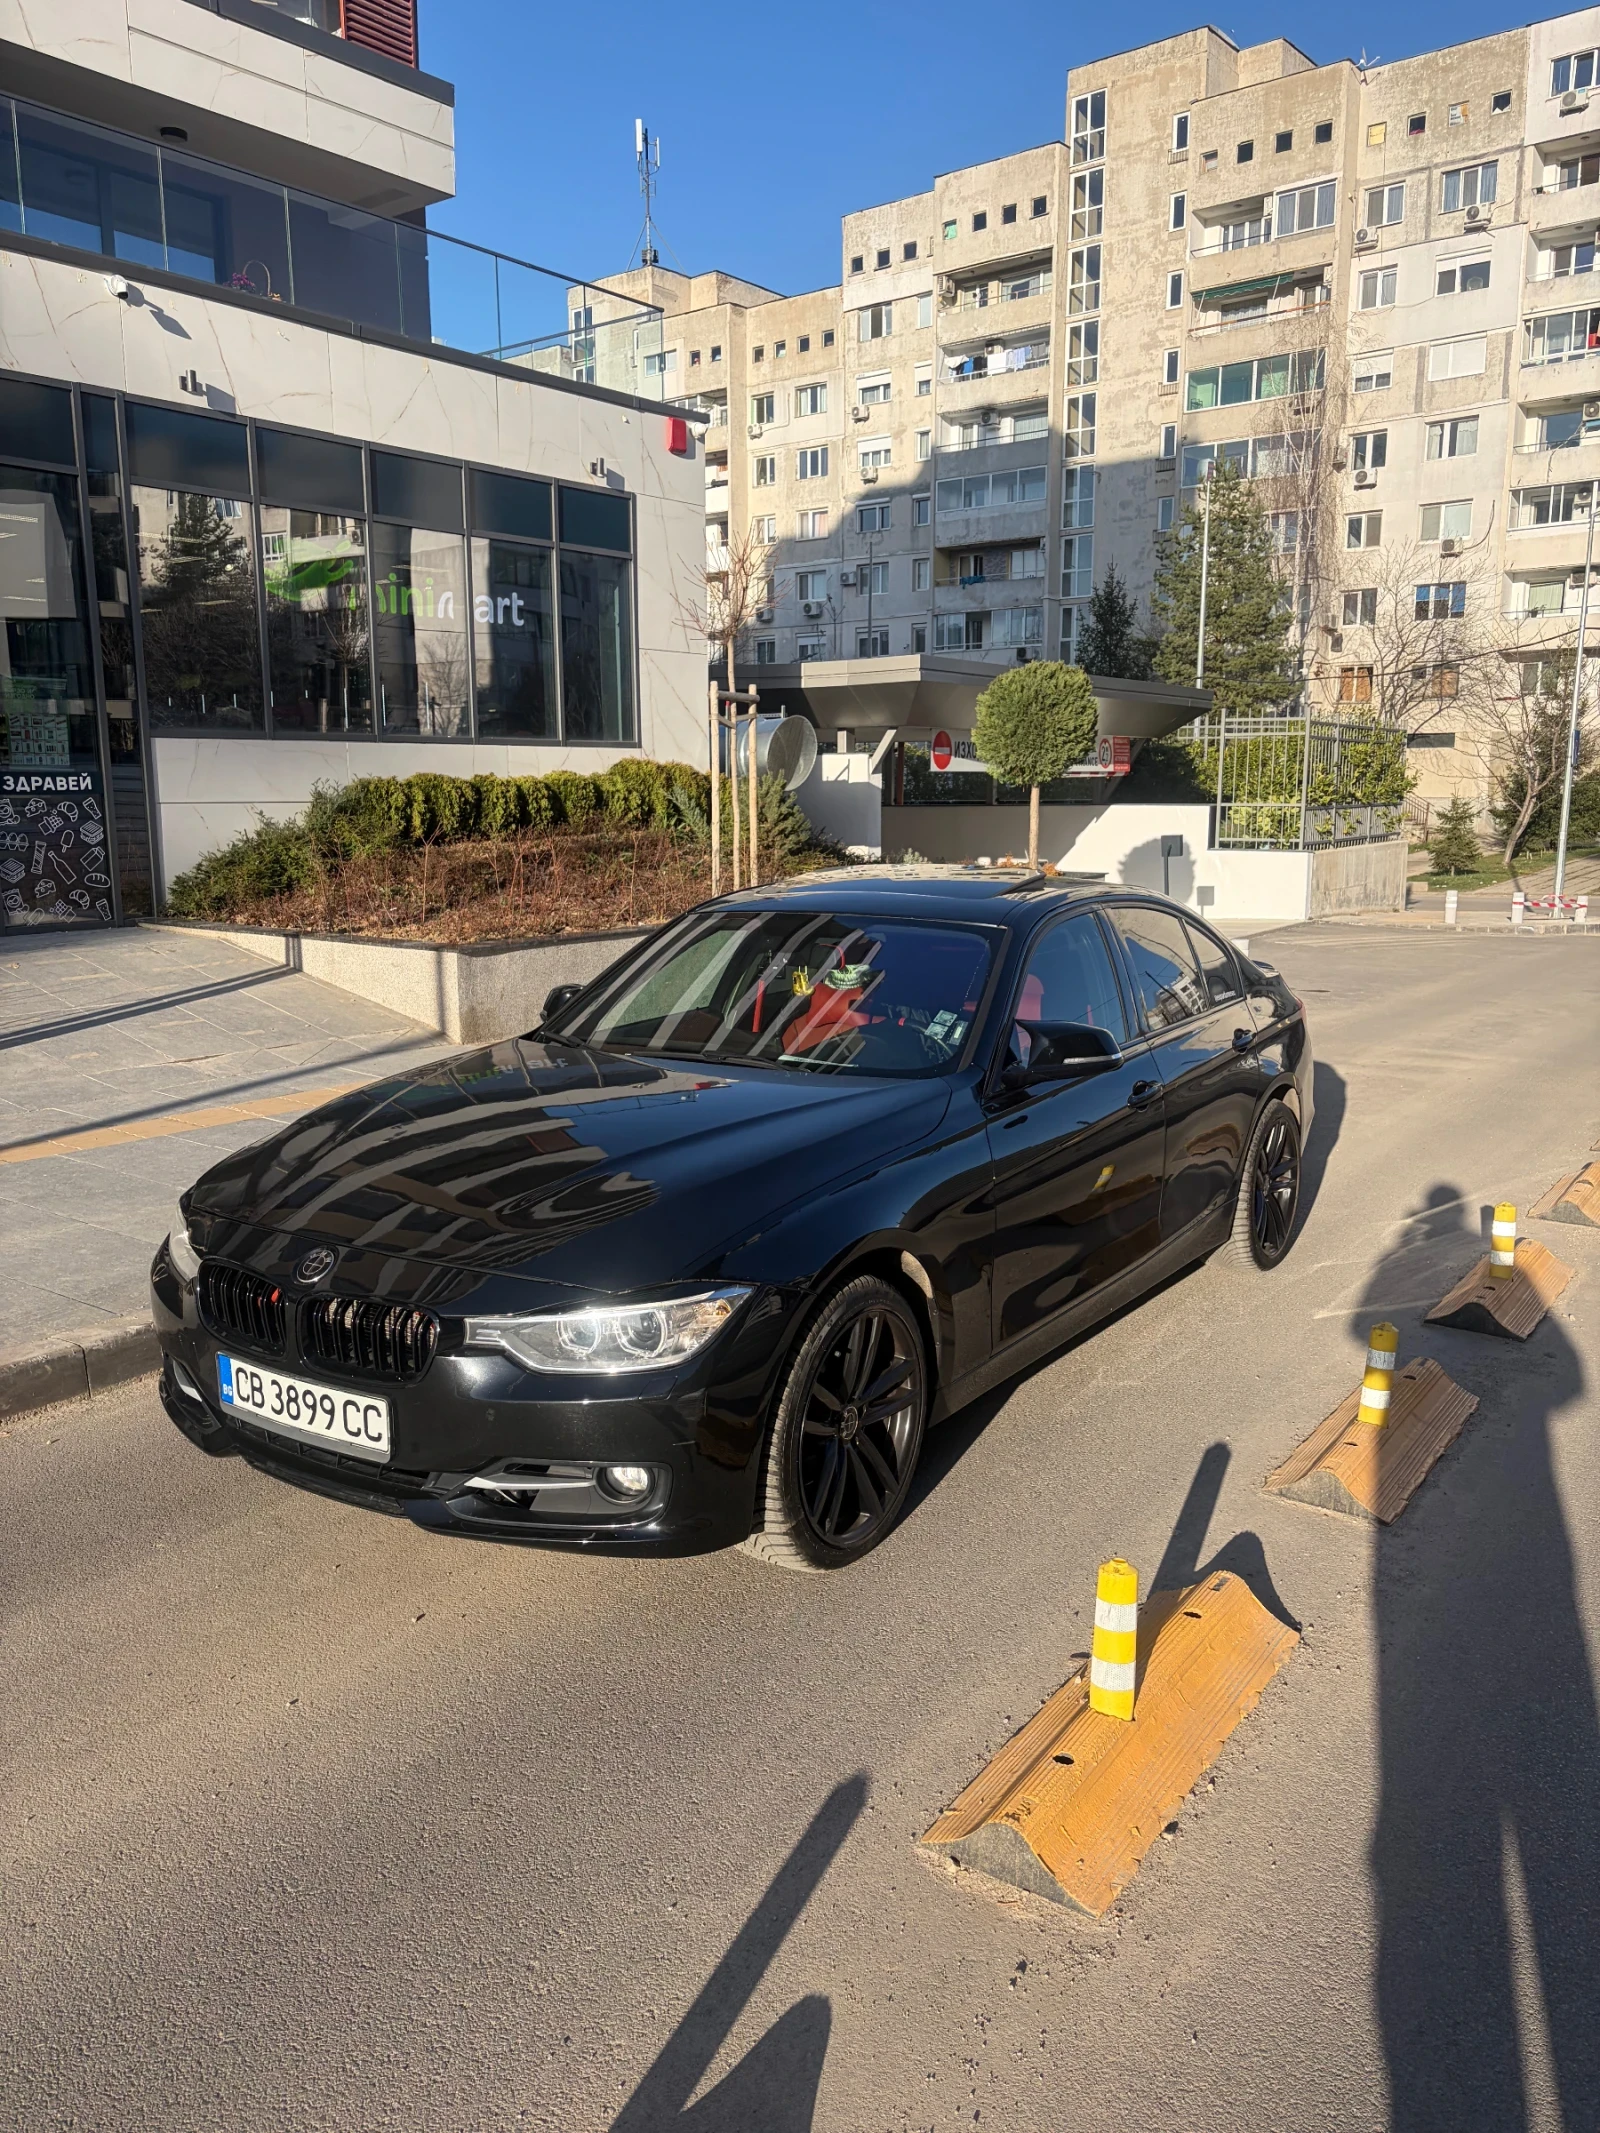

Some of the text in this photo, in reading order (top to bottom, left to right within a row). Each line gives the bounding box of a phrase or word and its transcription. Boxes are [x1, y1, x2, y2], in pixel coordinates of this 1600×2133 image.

[954, 741, 978, 759] ИЗХО
[2, 773, 93, 793] ЗДРАВЕЙ
[222, 1383, 233, 1397] BG
[235, 1367, 383, 1443] CB 3899 CC
